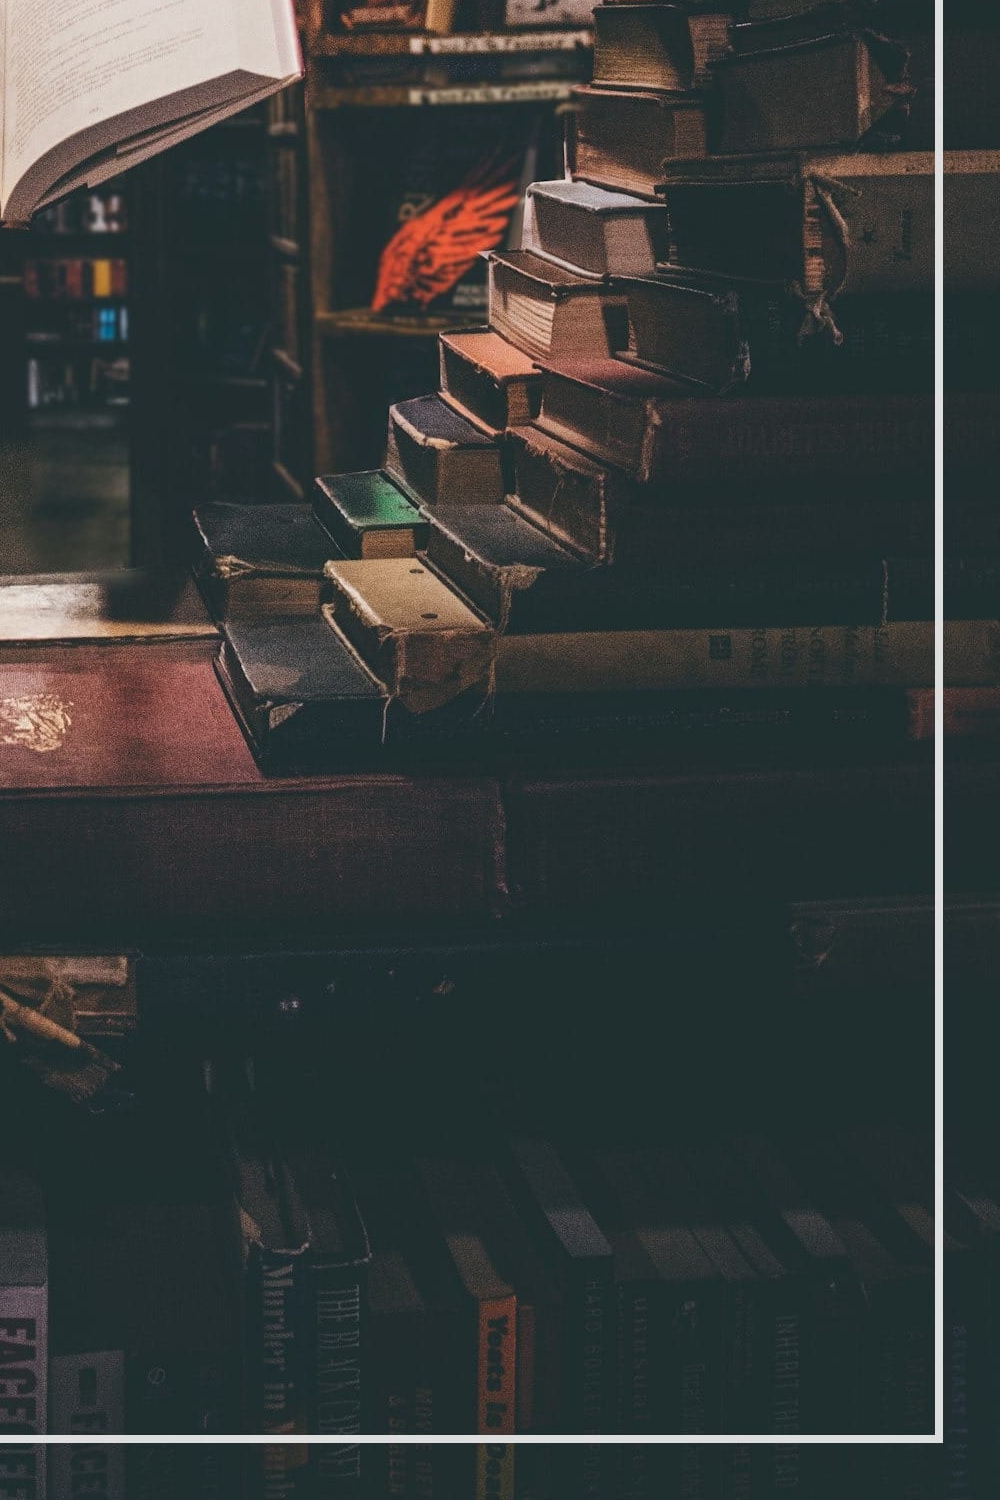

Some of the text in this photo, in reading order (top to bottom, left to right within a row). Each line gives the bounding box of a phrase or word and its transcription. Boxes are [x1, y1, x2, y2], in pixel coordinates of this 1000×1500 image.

[263, 1264, 295, 1370] Murder
[316, 1284, 359, 1323] THE
[316, 1330, 360, 1393] BLACK
[487, 1316, 507, 1391] Yeats
[775, 1315, 799, 1389] INHERIT
[263, 1382, 294, 1409] in
[414, 1388, 432, 1450] MOVE
[486, 1402, 506, 1427] Is
[388, 1417, 405, 1492] SREEN
